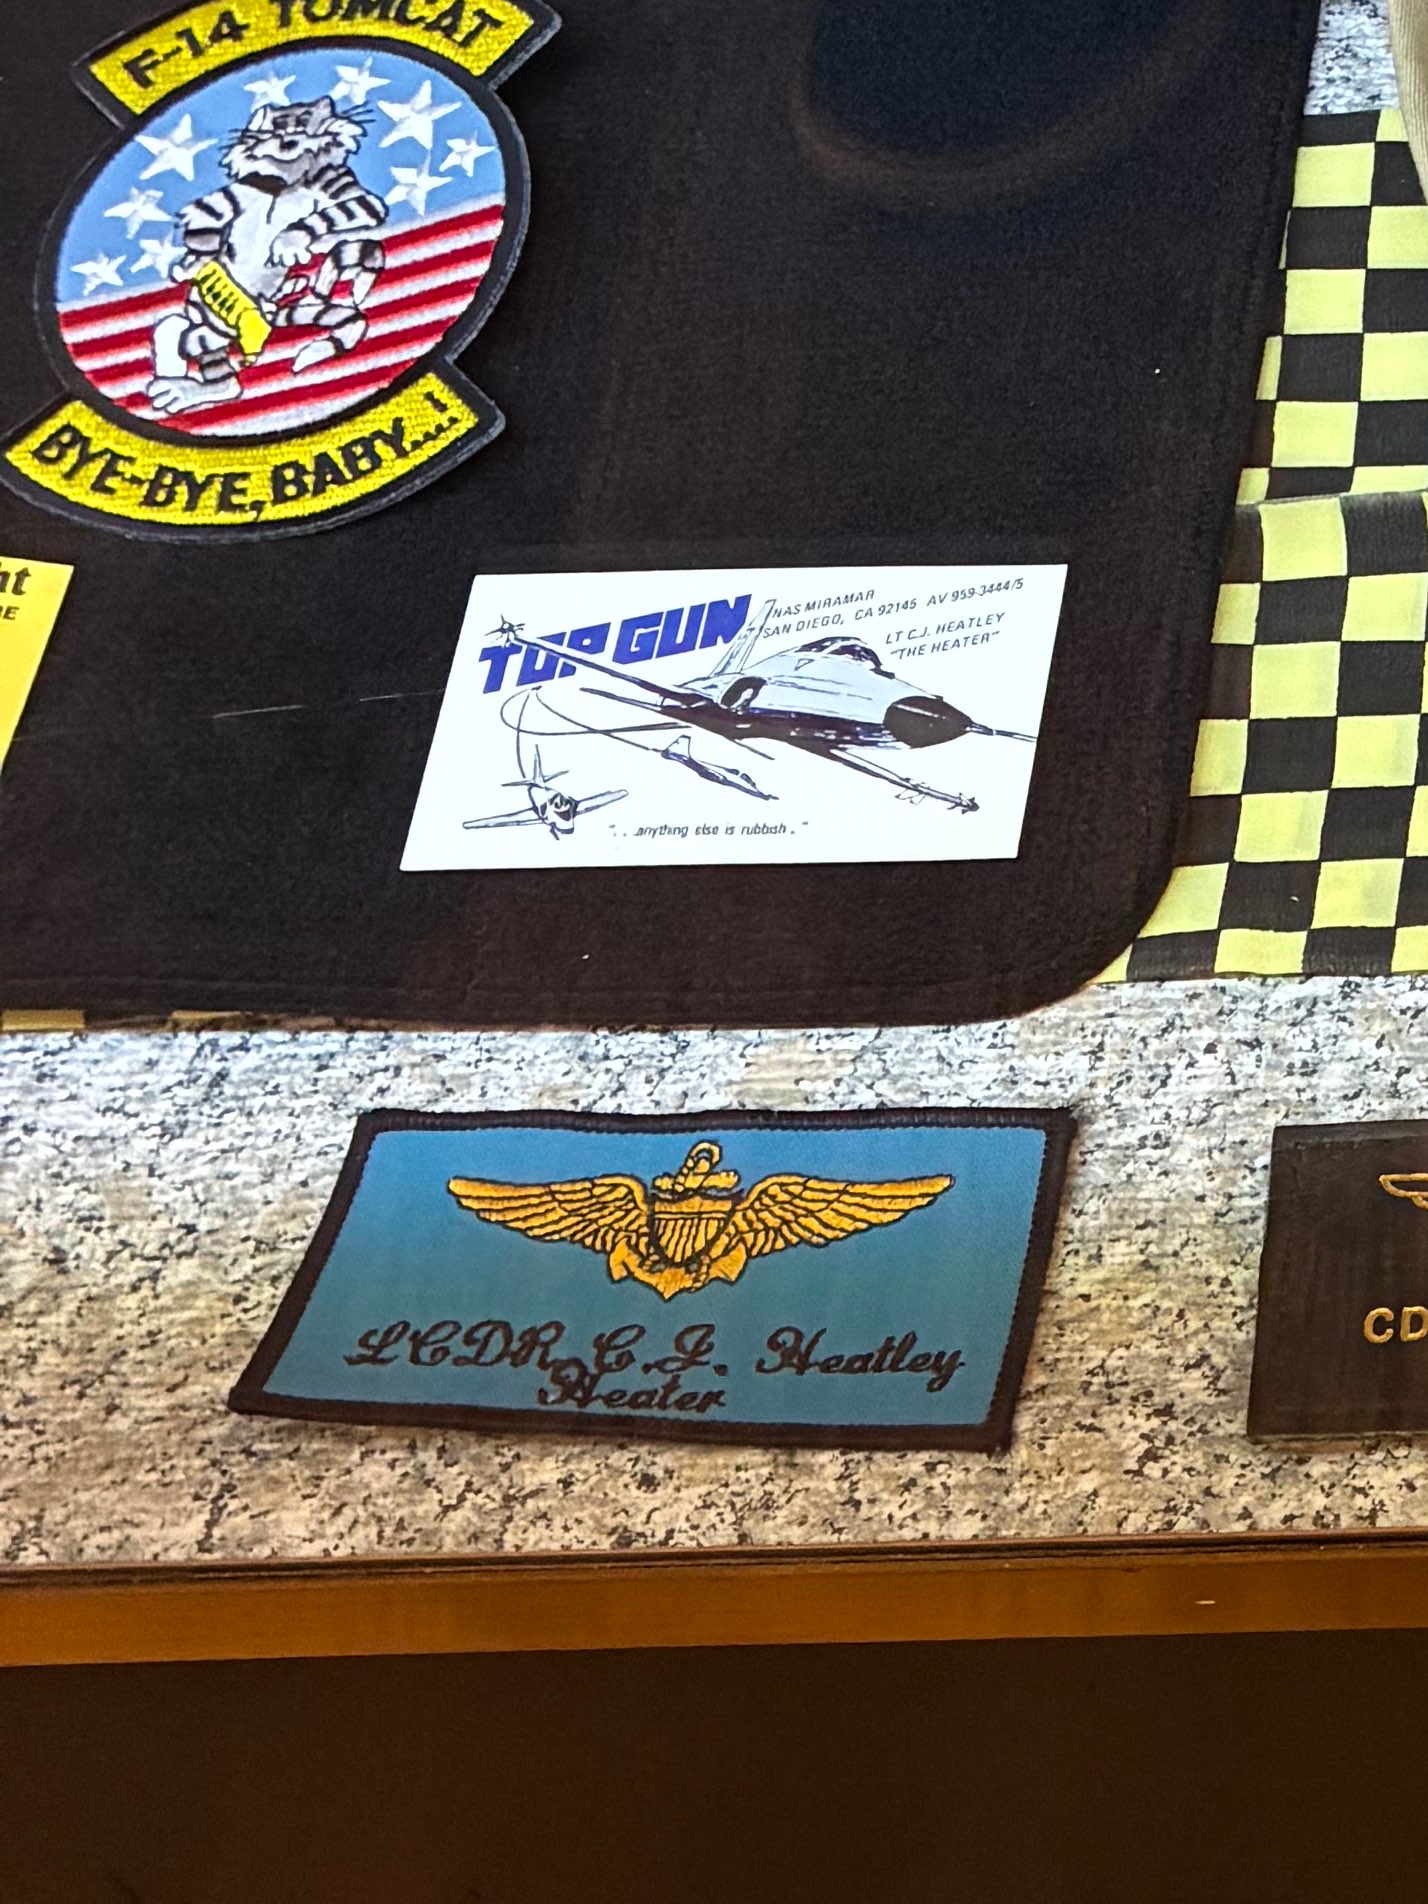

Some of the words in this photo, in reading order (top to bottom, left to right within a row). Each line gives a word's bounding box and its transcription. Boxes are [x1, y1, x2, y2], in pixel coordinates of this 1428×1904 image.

[122, 14, 250, 90] F-14
[31, 423, 266, 523] BYE-BYE,
[762, 622, 792, 638] SAN
[795, 613, 845, 632] DIEGO,
[854, 607, 874, 621] CA
[878, 598, 917, 616] 92145
[926, 592, 949, 607] AV
[772, 604, 801, 618] NAS
[804, 589, 875, 613] MIRAMAR
[885, 630, 904, 644] LT
[936, 612, 1005, 634] HEATLEY
[478, 621, 612, 694] TOP
[611, 593, 752, 665] GUN
[694, 824, 719, 836] else
[725, 826, 736, 836] is
[537, 1357, 726, 1413] Heater
[756, 1326, 966, 1393] Heatley
